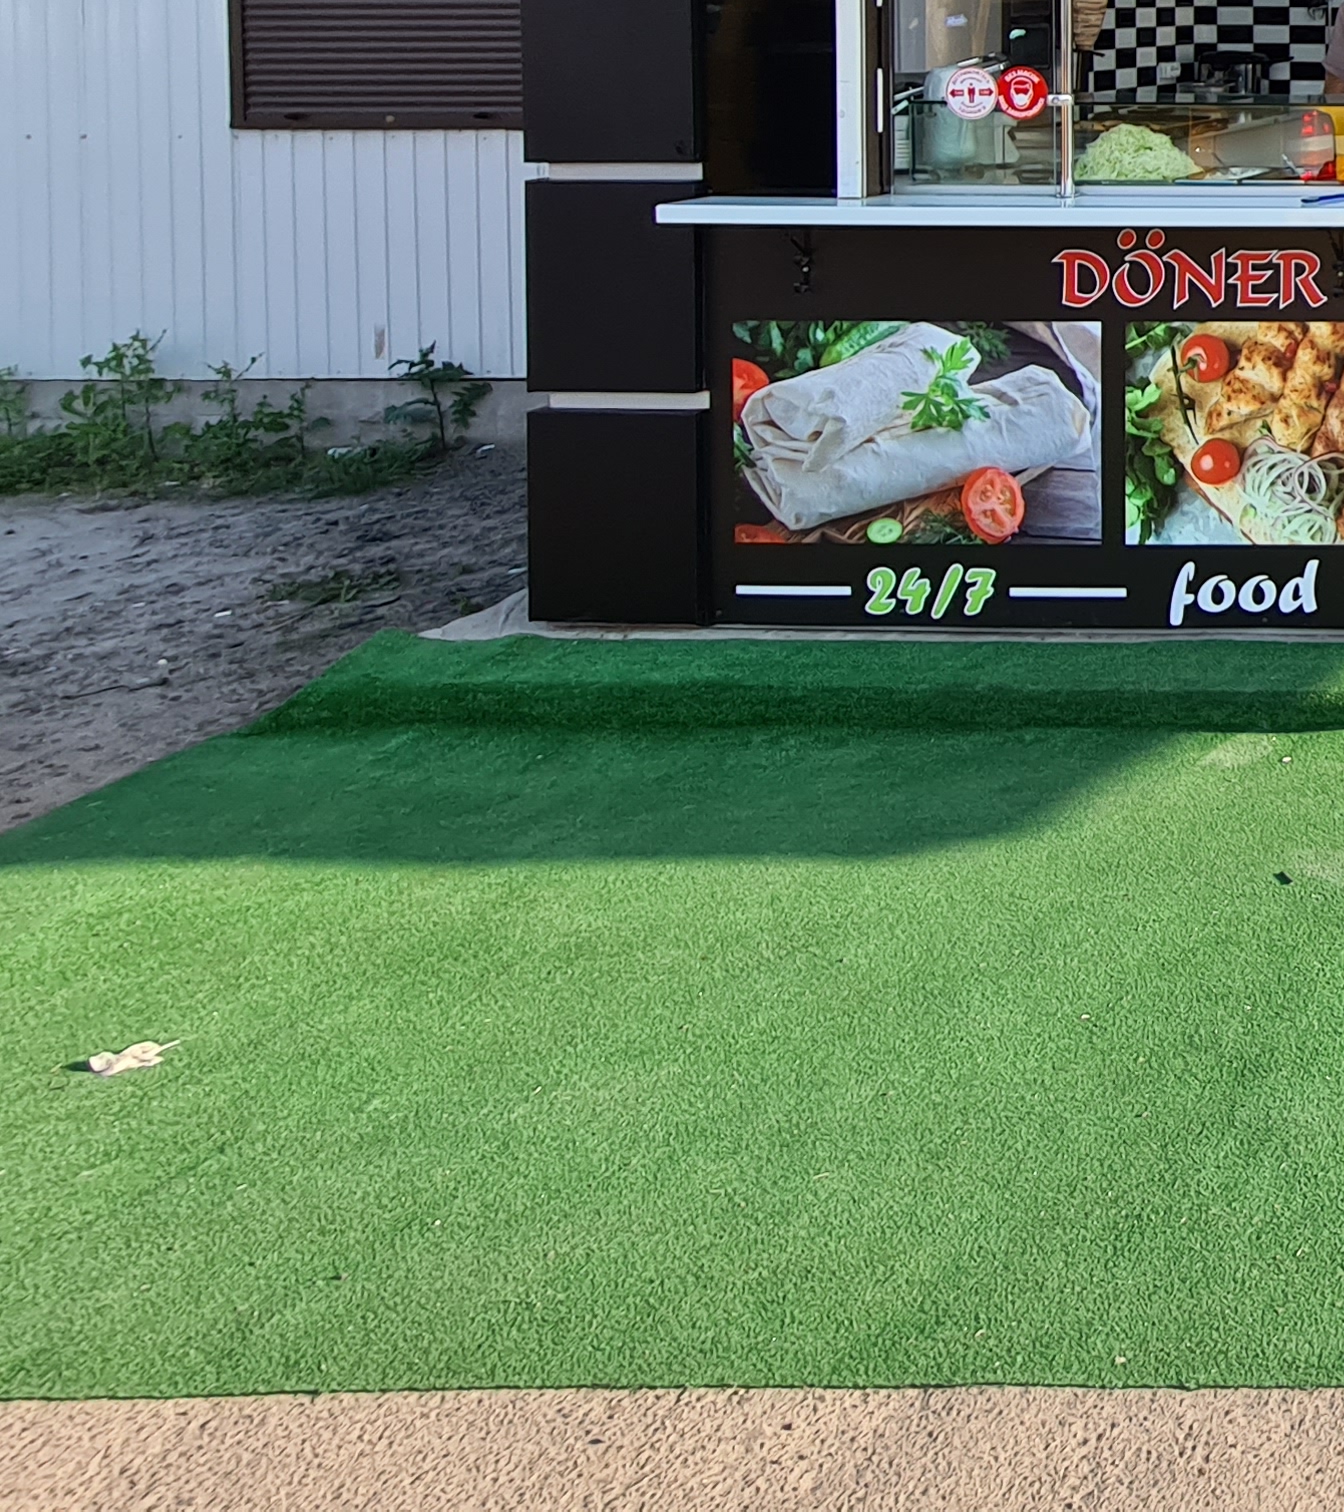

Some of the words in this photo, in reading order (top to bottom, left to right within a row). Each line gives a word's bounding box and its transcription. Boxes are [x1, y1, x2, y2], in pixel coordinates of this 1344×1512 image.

[1051, 228, 1328, 309] DÖNER
[865, 563, 997, 619] 24/7
[1168, 559, 1321, 626] food
